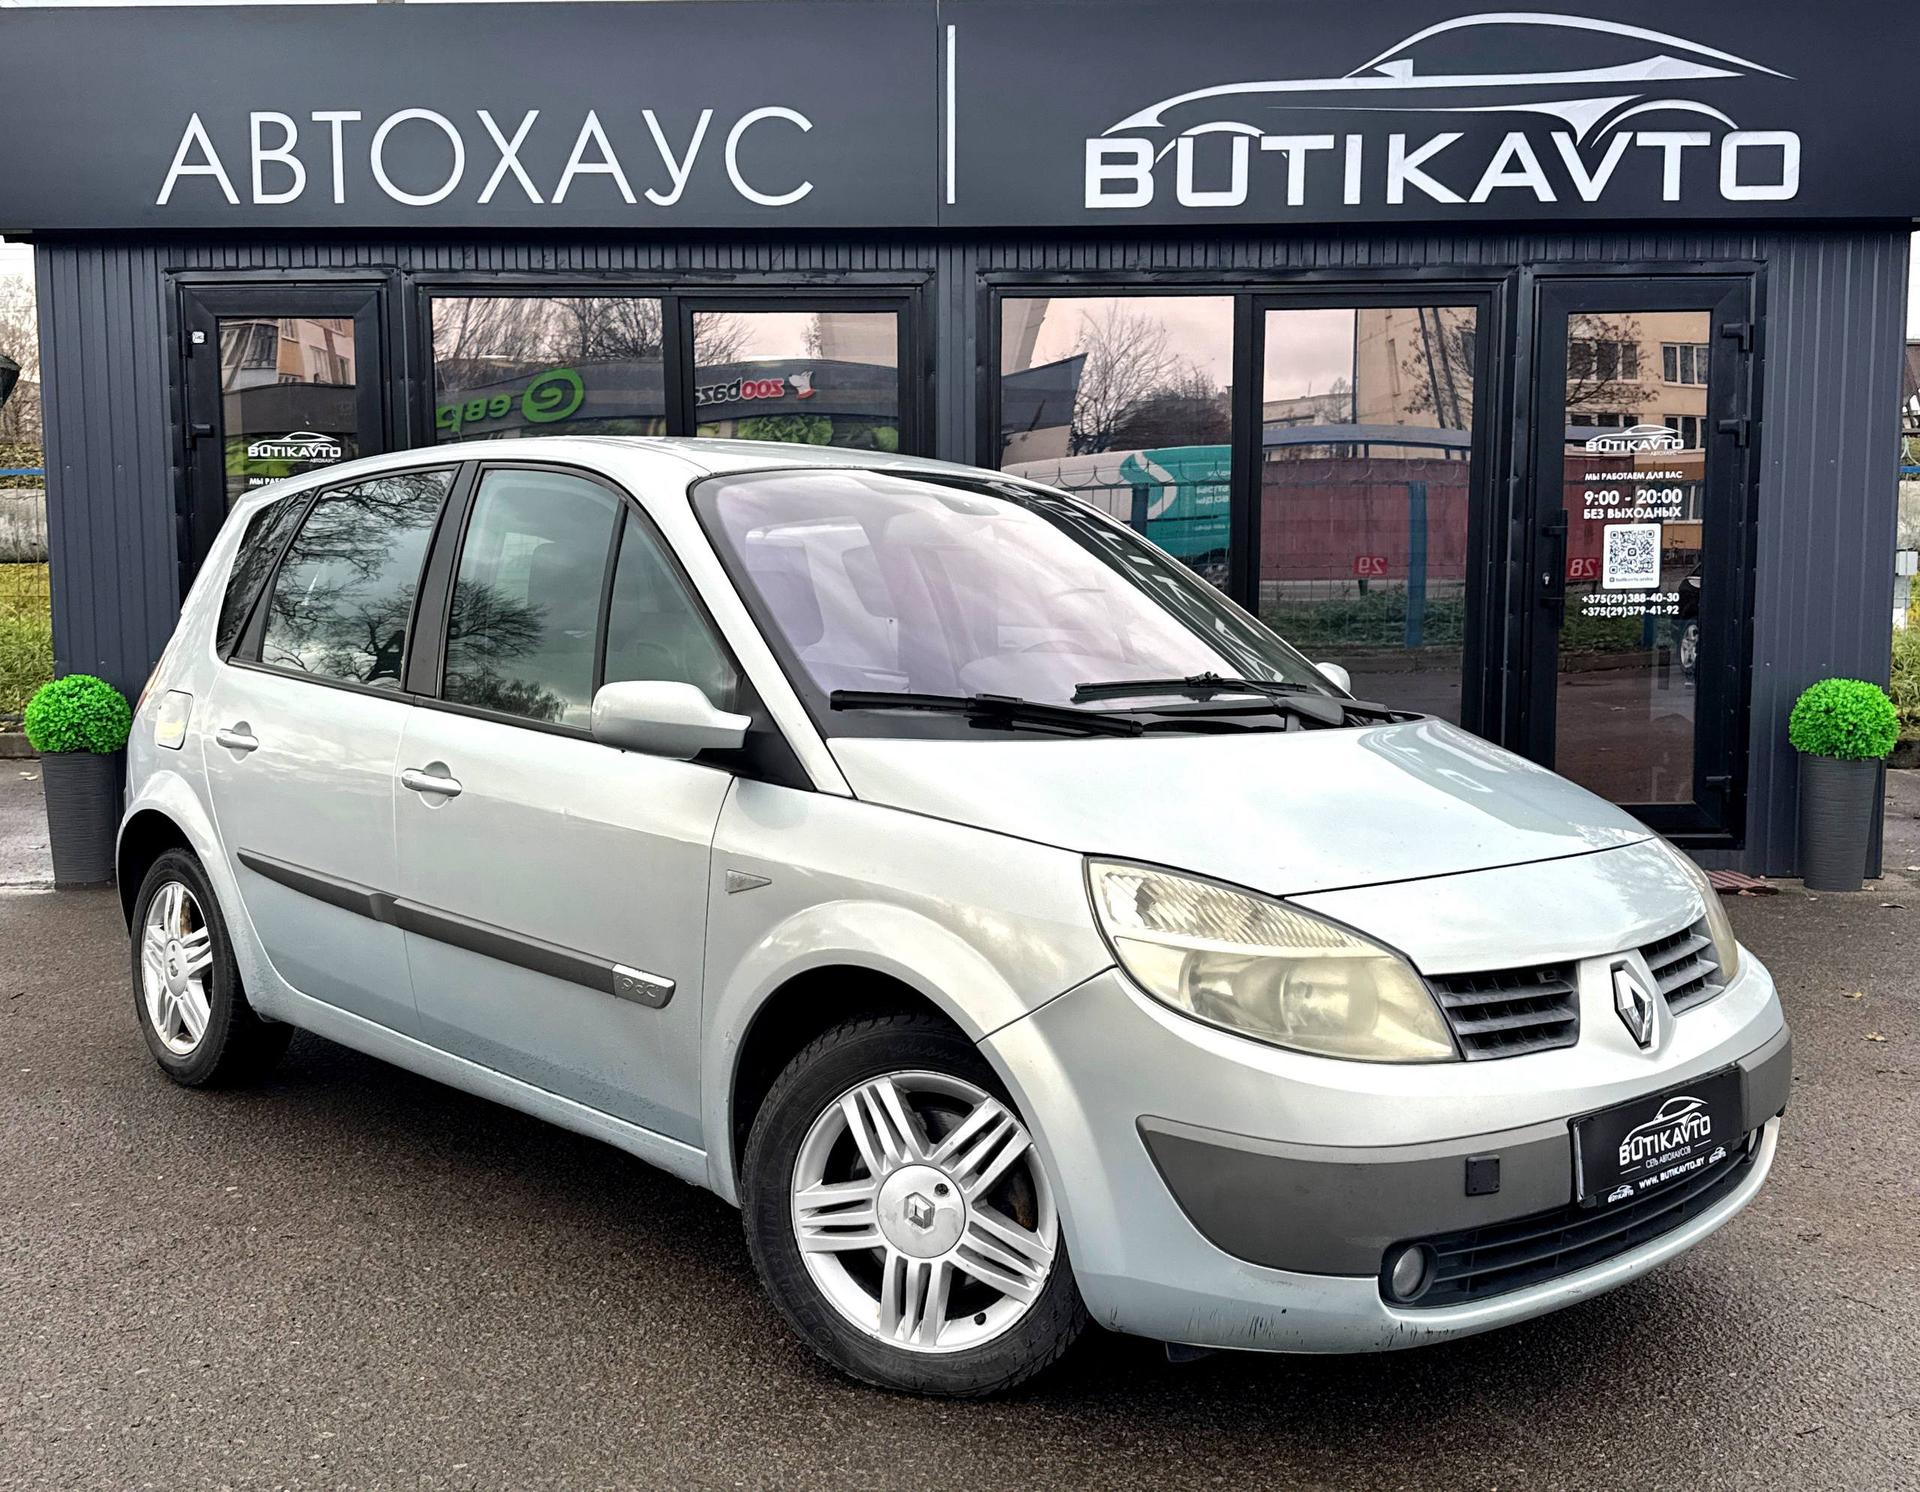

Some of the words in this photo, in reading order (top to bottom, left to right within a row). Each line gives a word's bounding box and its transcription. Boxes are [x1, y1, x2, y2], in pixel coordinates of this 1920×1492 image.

[155, 106, 814, 207] АВТОХАУС
[1085, 129, 1802, 209] BUTIKAVTO
[247, 446, 341, 458] BUTIKAVTO
[1586, 439, 1684, 452] BUTIKAVTO
[249, 477, 264, 486] МЫ
[1585, 473, 1600, 481] МЫ
[1601, 471, 1645, 480] РАБОТАЕМ
[1646, 471, 1664, 480] ДЛЯ
[1665, 471, 1683, 479] ВАС
[1584, 490, 1620, 505] 9:00
[1636, 488, 1683, 504] 20:00
[1583, 508, 1604, 520] БЕЗ
[1607, 506, 1682, 519] ВЫХОДНЫХ
[1581, 593, 1680, 606] +375(29)388-40-30
[1581, 605, 1680, 618] +375(29)379-41-92
[1619, 1115, 1711, 1166] BUTIKAVTO
[1639, 1175, 1659, 1190] WWW.
[1660, 1157, 1705, 1181] BUTIKAVTO.BY
